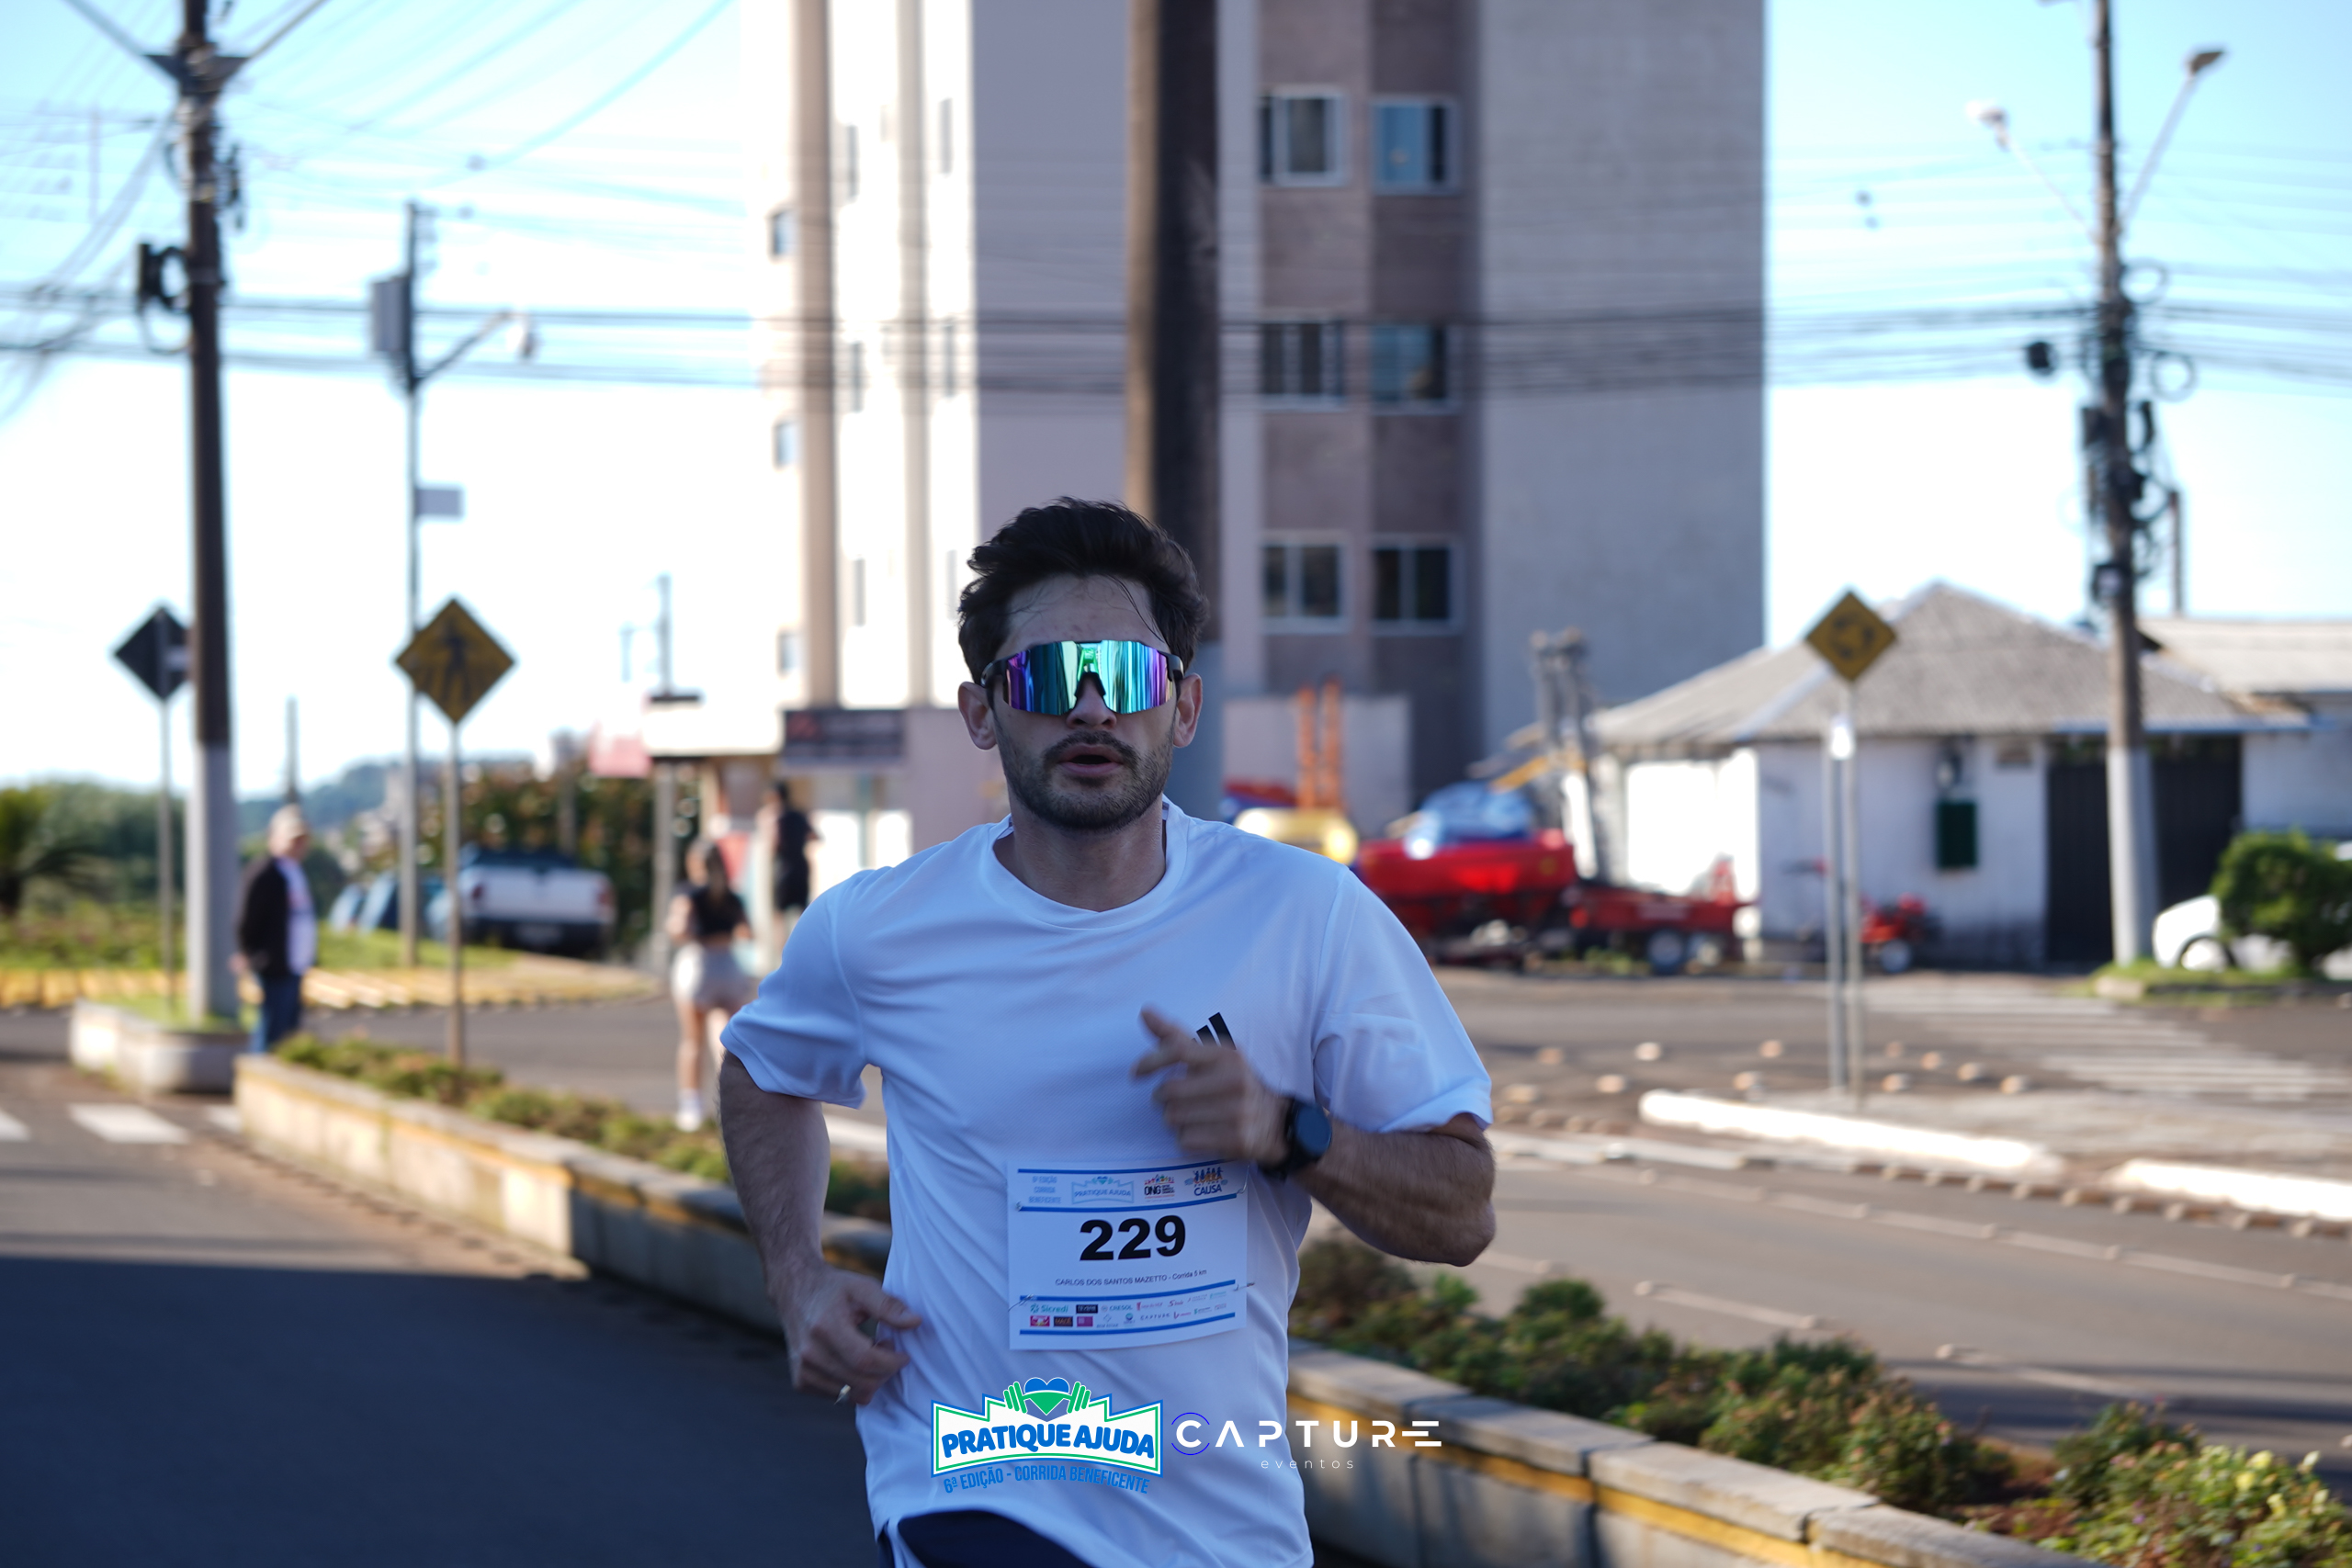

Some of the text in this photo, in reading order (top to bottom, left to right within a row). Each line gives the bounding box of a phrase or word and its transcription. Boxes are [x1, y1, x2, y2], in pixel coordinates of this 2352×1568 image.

[1144, 1185, 1161, 1195] ONG
[1193, 1184, 1222, 1196] CAUSA
[1080, 1214, 1186, 1261] 229
[1103, 1277, 1133, 1285] SANTOS
[1134, 1274, 1167, 1283] MAZETTO
[1172, 1272, 1193, 1280] Corrida
[1041, 1304, 1069, 1313] Sicredi
